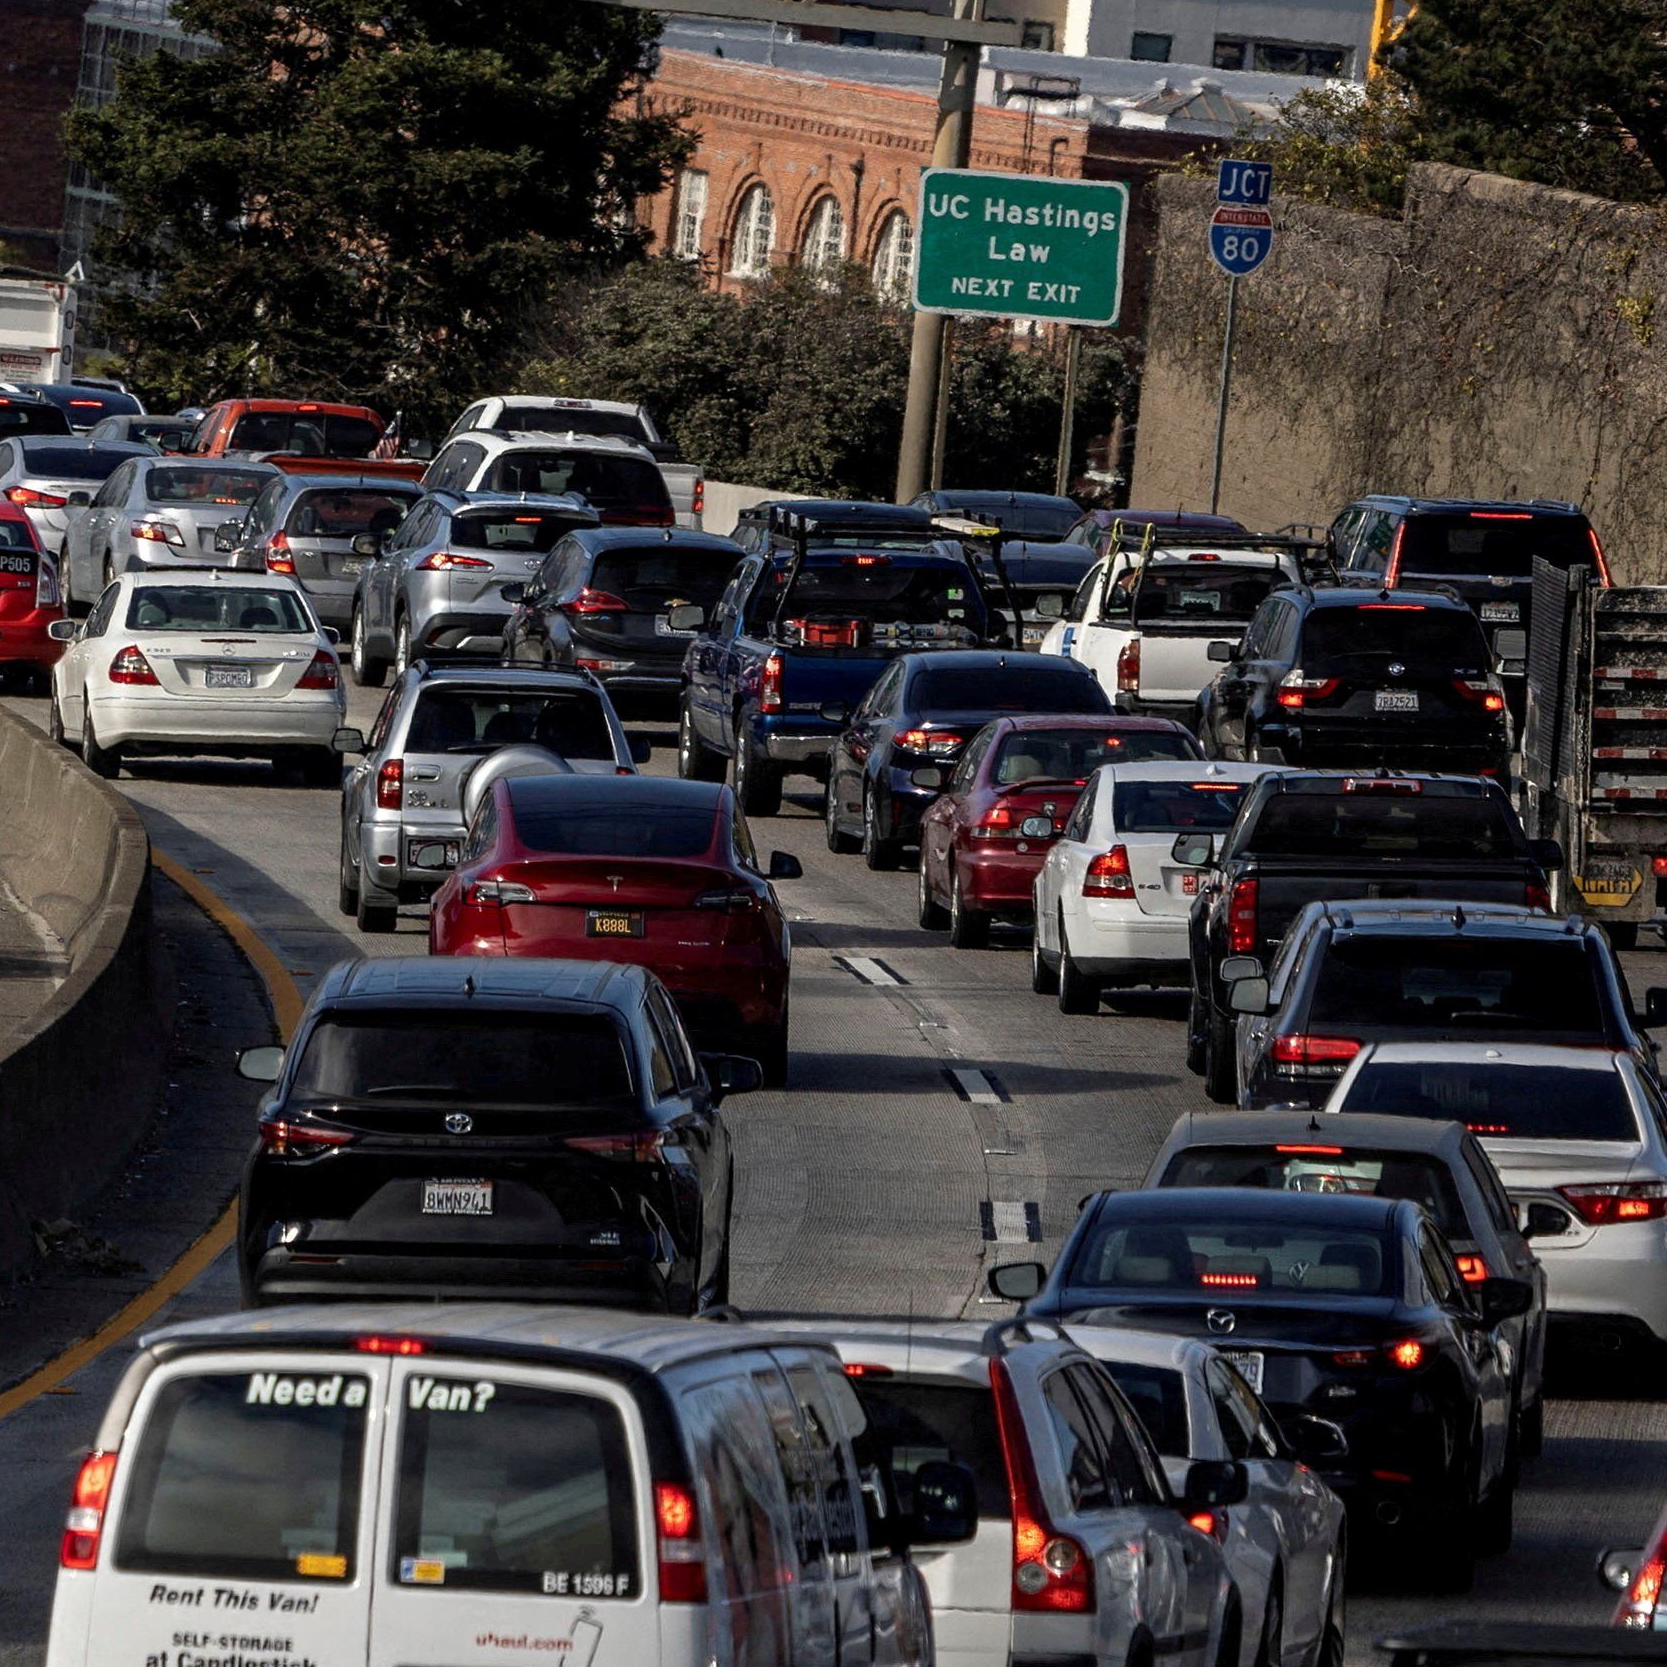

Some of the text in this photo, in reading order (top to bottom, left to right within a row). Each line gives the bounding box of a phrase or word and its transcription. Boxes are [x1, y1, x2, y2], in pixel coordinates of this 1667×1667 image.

[1222, 168, 1269, 198] JCT
[929, 192, 1116, 238] UC Hastings
[989, 236, 1050, 264] Law
[1223, 236, 1259, 262] 80
[952, 276, 1081, 304] NEXT EXIT
[0, 556, 30, 572] P505
[595, 918, 632, 933] K888L
[427, 1192, 487, 1209] 8WMN941
[246, 1373, 496, 1412] Need a Van?
[543, 1571, 568, 1593] BE
[617, 1575, 629, 1596] F
[149, 1584, 319, 1614] Rent This Van!
[476, 1632, 573, 1652] uhaul.com
